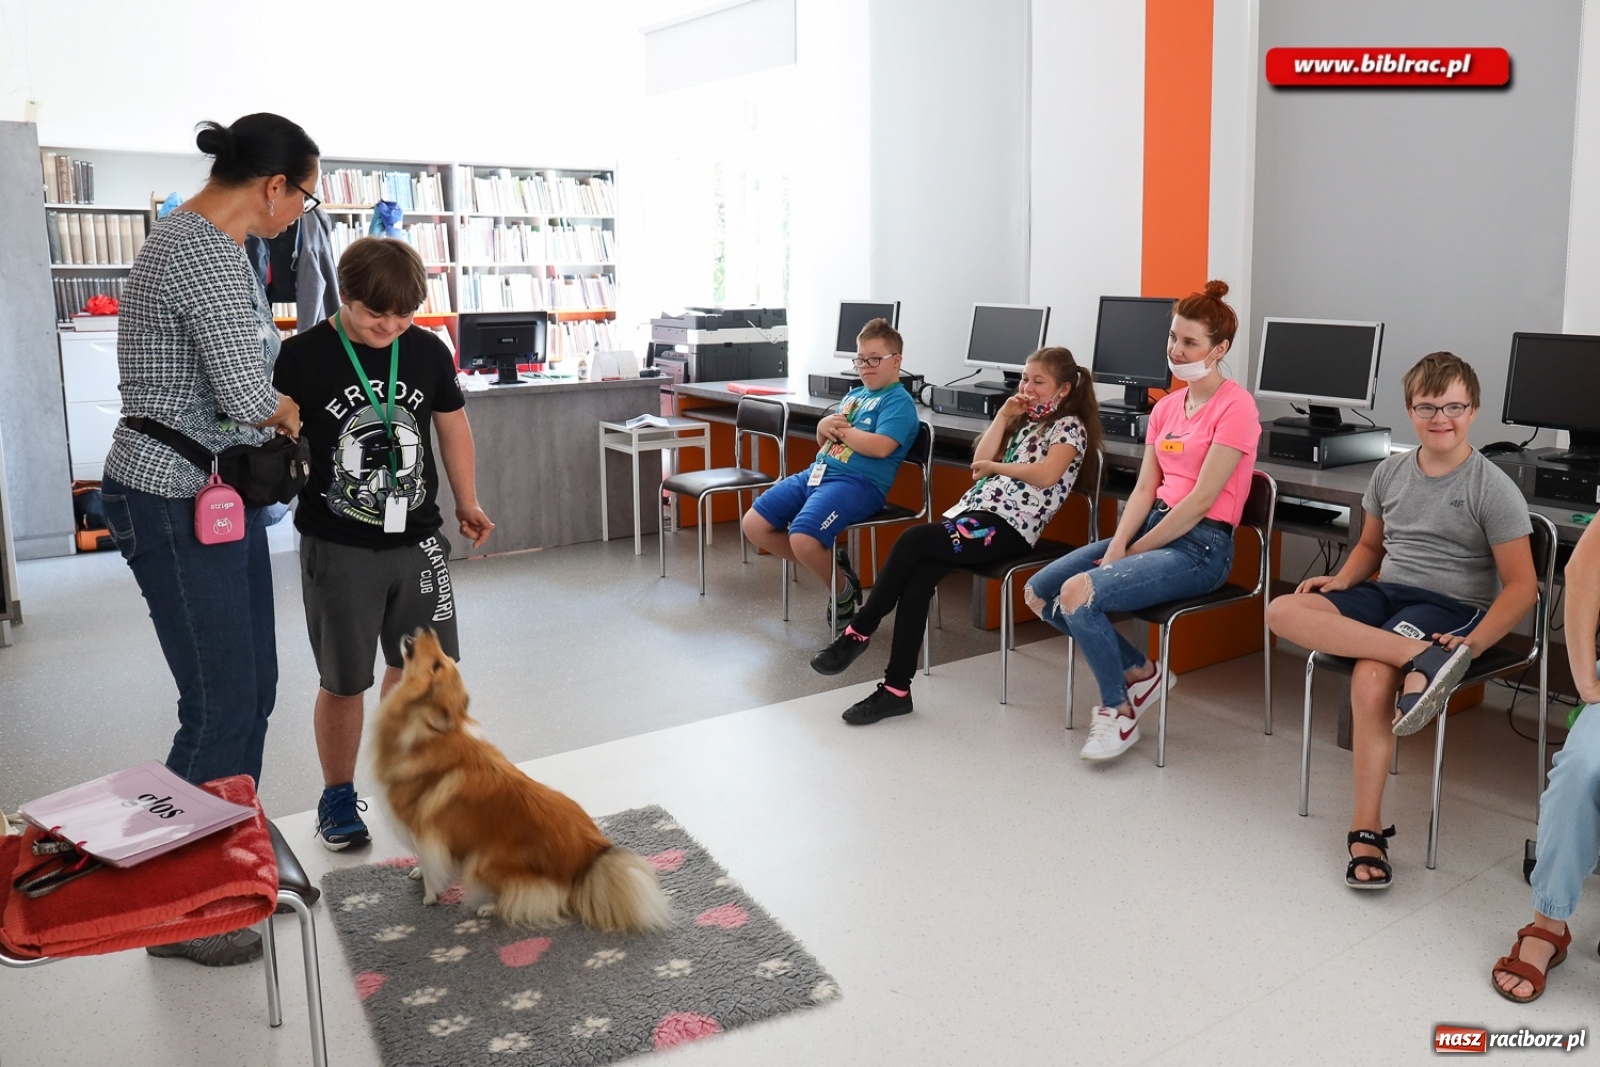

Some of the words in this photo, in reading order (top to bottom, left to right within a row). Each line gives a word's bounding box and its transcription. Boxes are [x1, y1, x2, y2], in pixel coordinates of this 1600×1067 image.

[325, 380, 424, 419] ERROR
[418, 536, 454, 622] SKATEBOARD
[419, 569, 434, 594] CLUB
[1359, 831, 1376, 840] FILA
